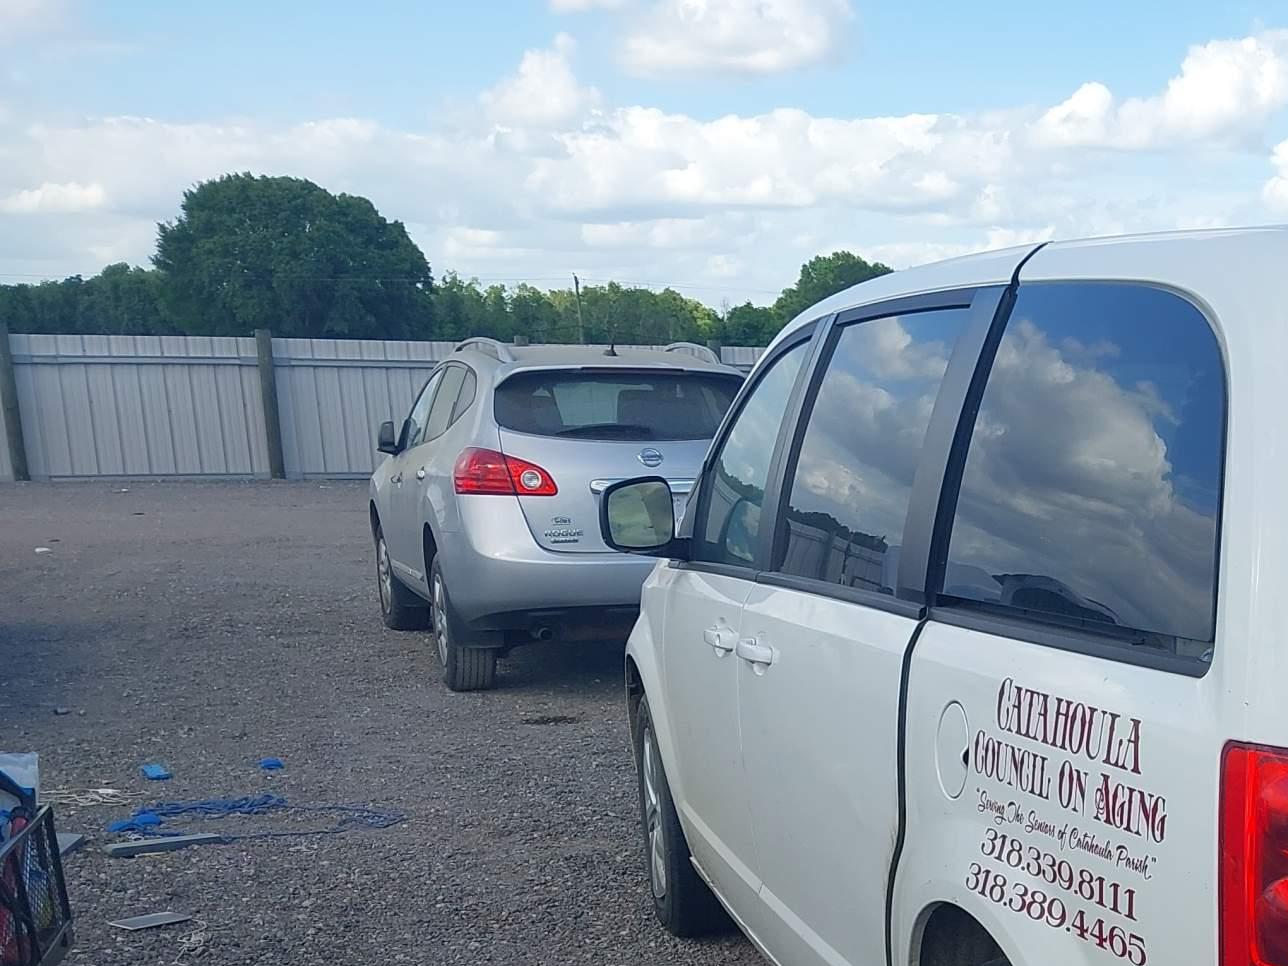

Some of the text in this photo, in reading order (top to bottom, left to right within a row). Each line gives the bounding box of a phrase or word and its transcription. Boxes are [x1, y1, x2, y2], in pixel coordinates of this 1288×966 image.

[997, 676, 1142, 775] CATAHOULA
[974, 729, 1167, 844] COUNCIL ON AGING
[1007, 801, 1025, 825] The
[1025, 810, 1056, 834] Seniors
[1057, 824, 1067, 852] of
[1069, 827, 1114, 861] Catahoula
[981, 826, 1138, 922] 318.339.8111
